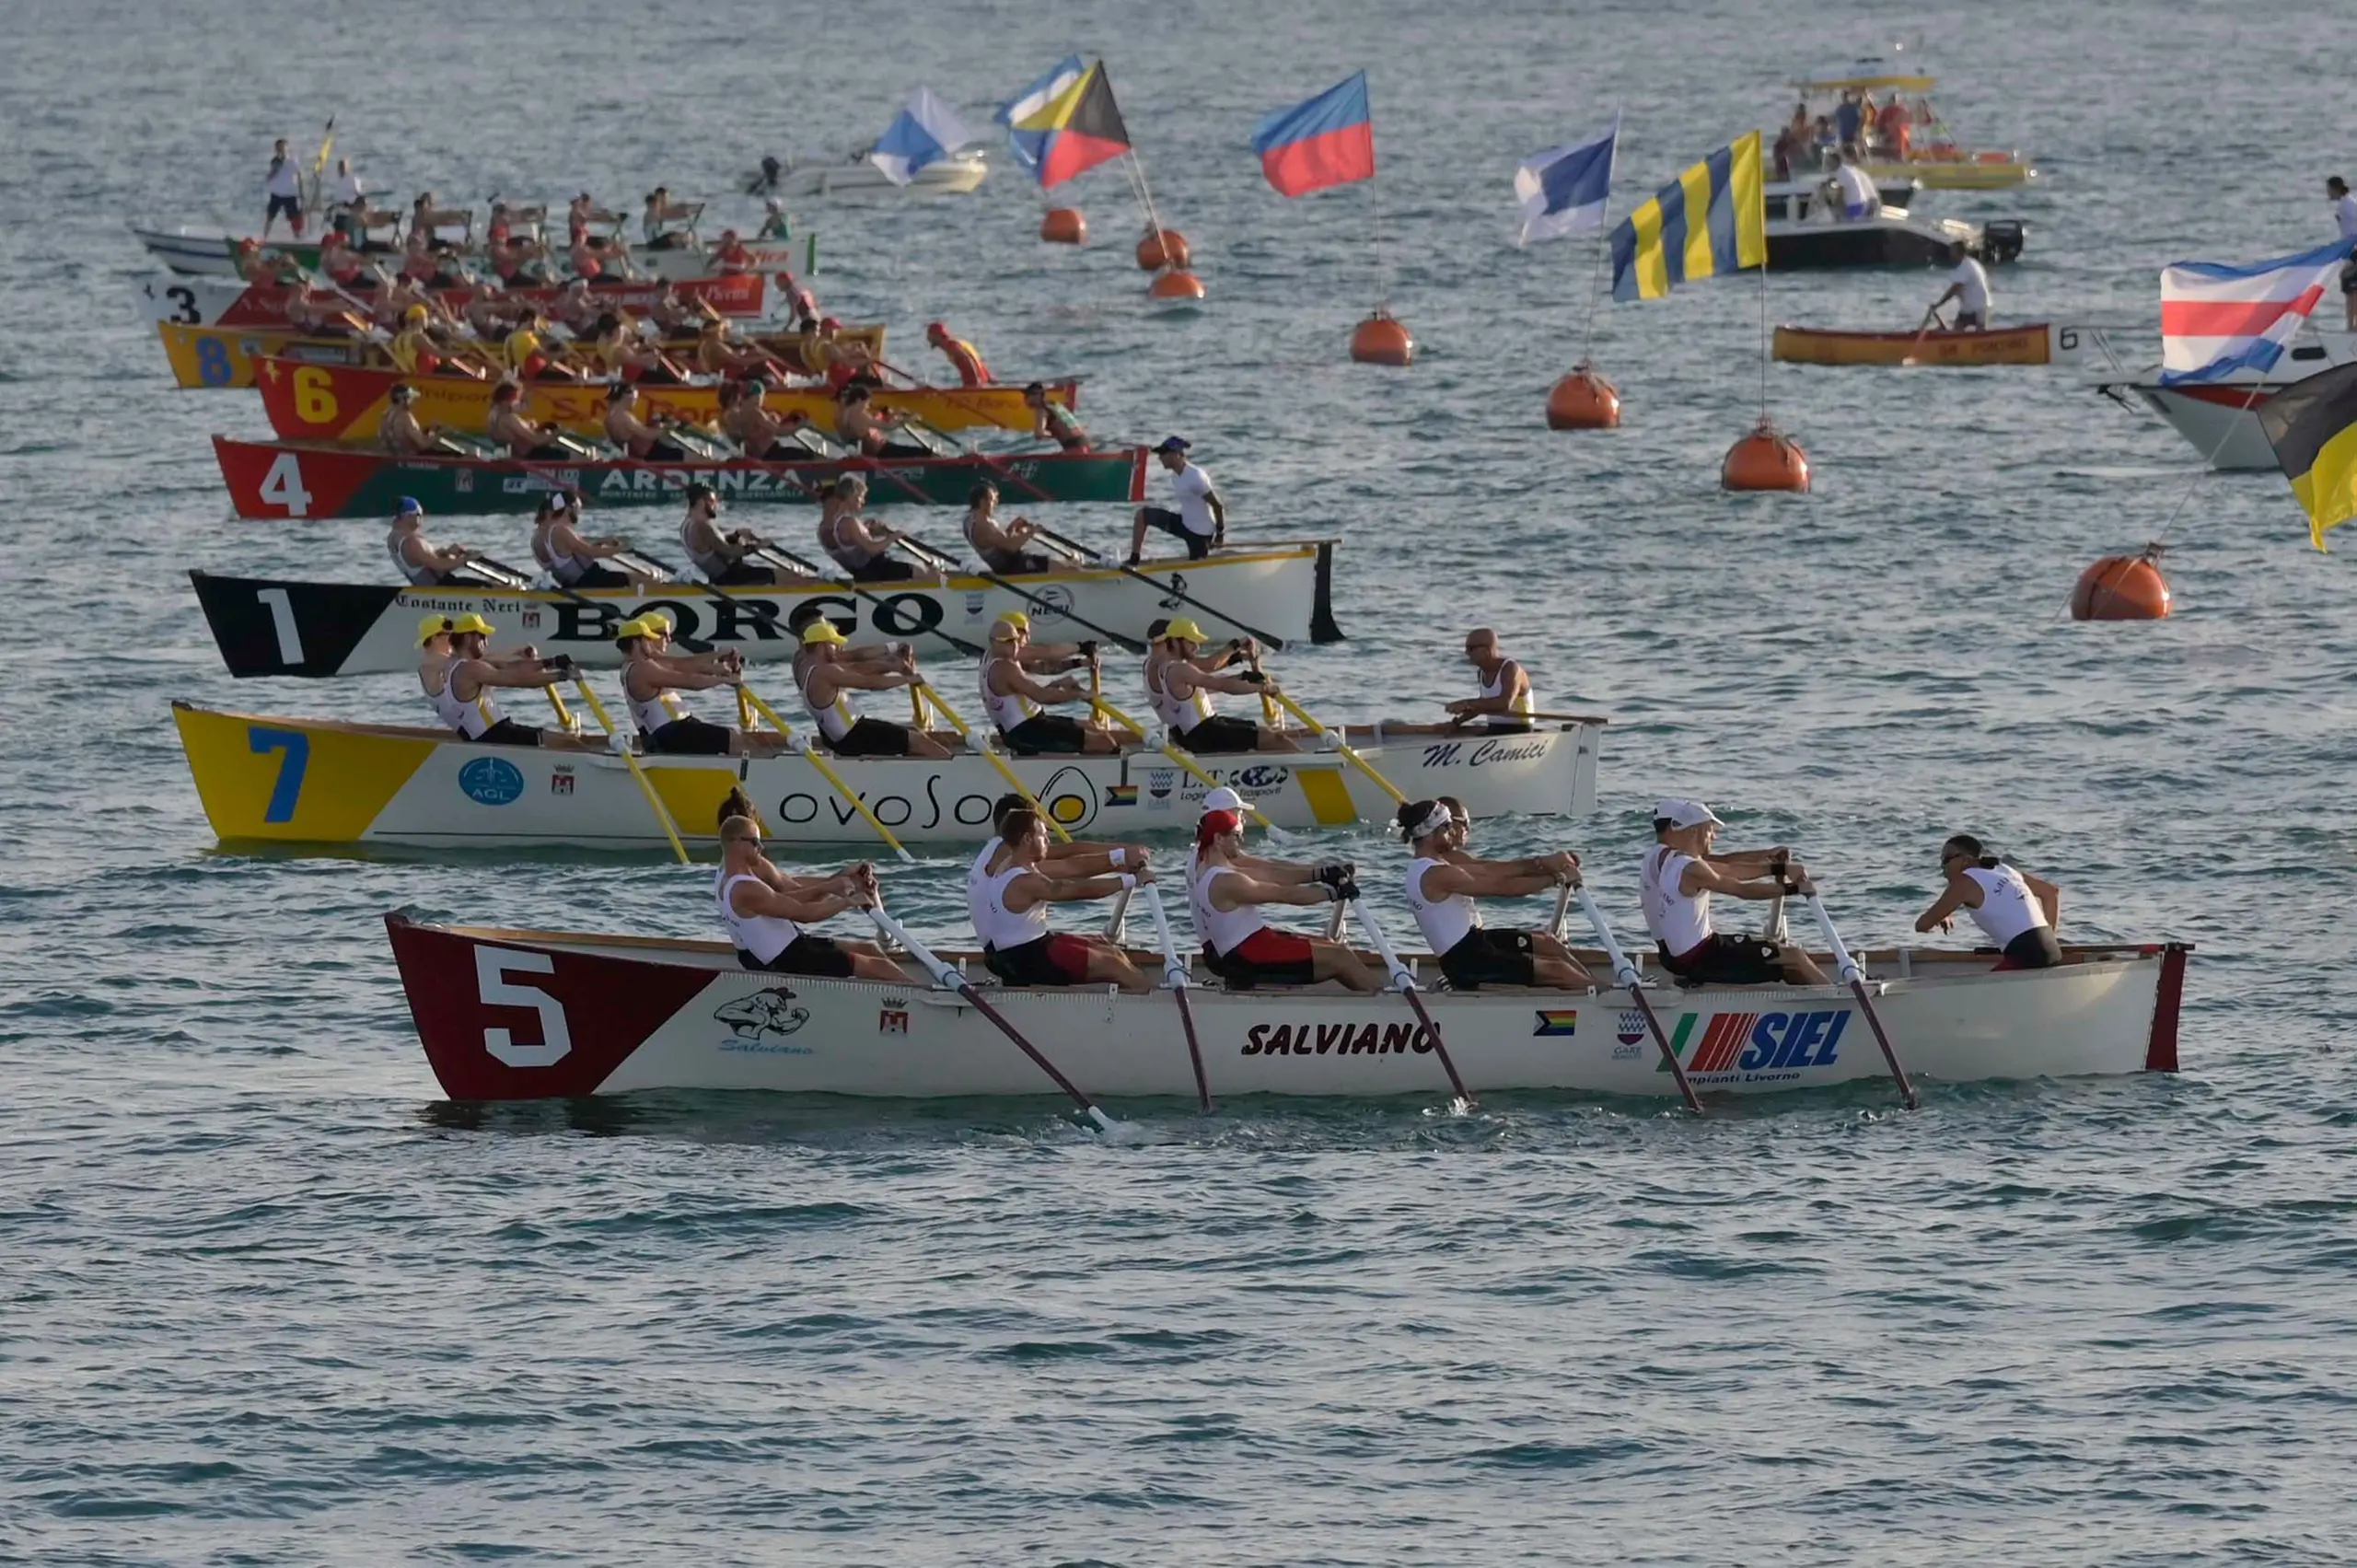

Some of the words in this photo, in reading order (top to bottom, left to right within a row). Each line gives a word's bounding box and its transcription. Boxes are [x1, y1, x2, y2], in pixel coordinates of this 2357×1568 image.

[166, 286, 201, 325] 3
[195, 335, 233, 385] 8
[2059, 326, 2079, 350] 6
[292, 366, 338, 424] 6
[259, 453, 312, 517] 4
[600, 467, 802, 491] ARDENZA
[257, 587, 305, 665] 1
[482, 598, 519, 613] Neri
[546, 591, 944, 642] BORGO
[248, 725, 311, 823] 7
[1422, 742, 1462, 768] M.
[1469, 738, 1549, 767] Camici
[471, 788, 510, 801] AGL
[473, 944, 573, 1068] 5
[1241, 1021, 1441, 1055] SALVIANO
[1738, 1010, 1852, 1071] SIEL
[1686, 1074, 1743, 1086] mpianti
[1745, 1071, 1801, 1083] Livorno
